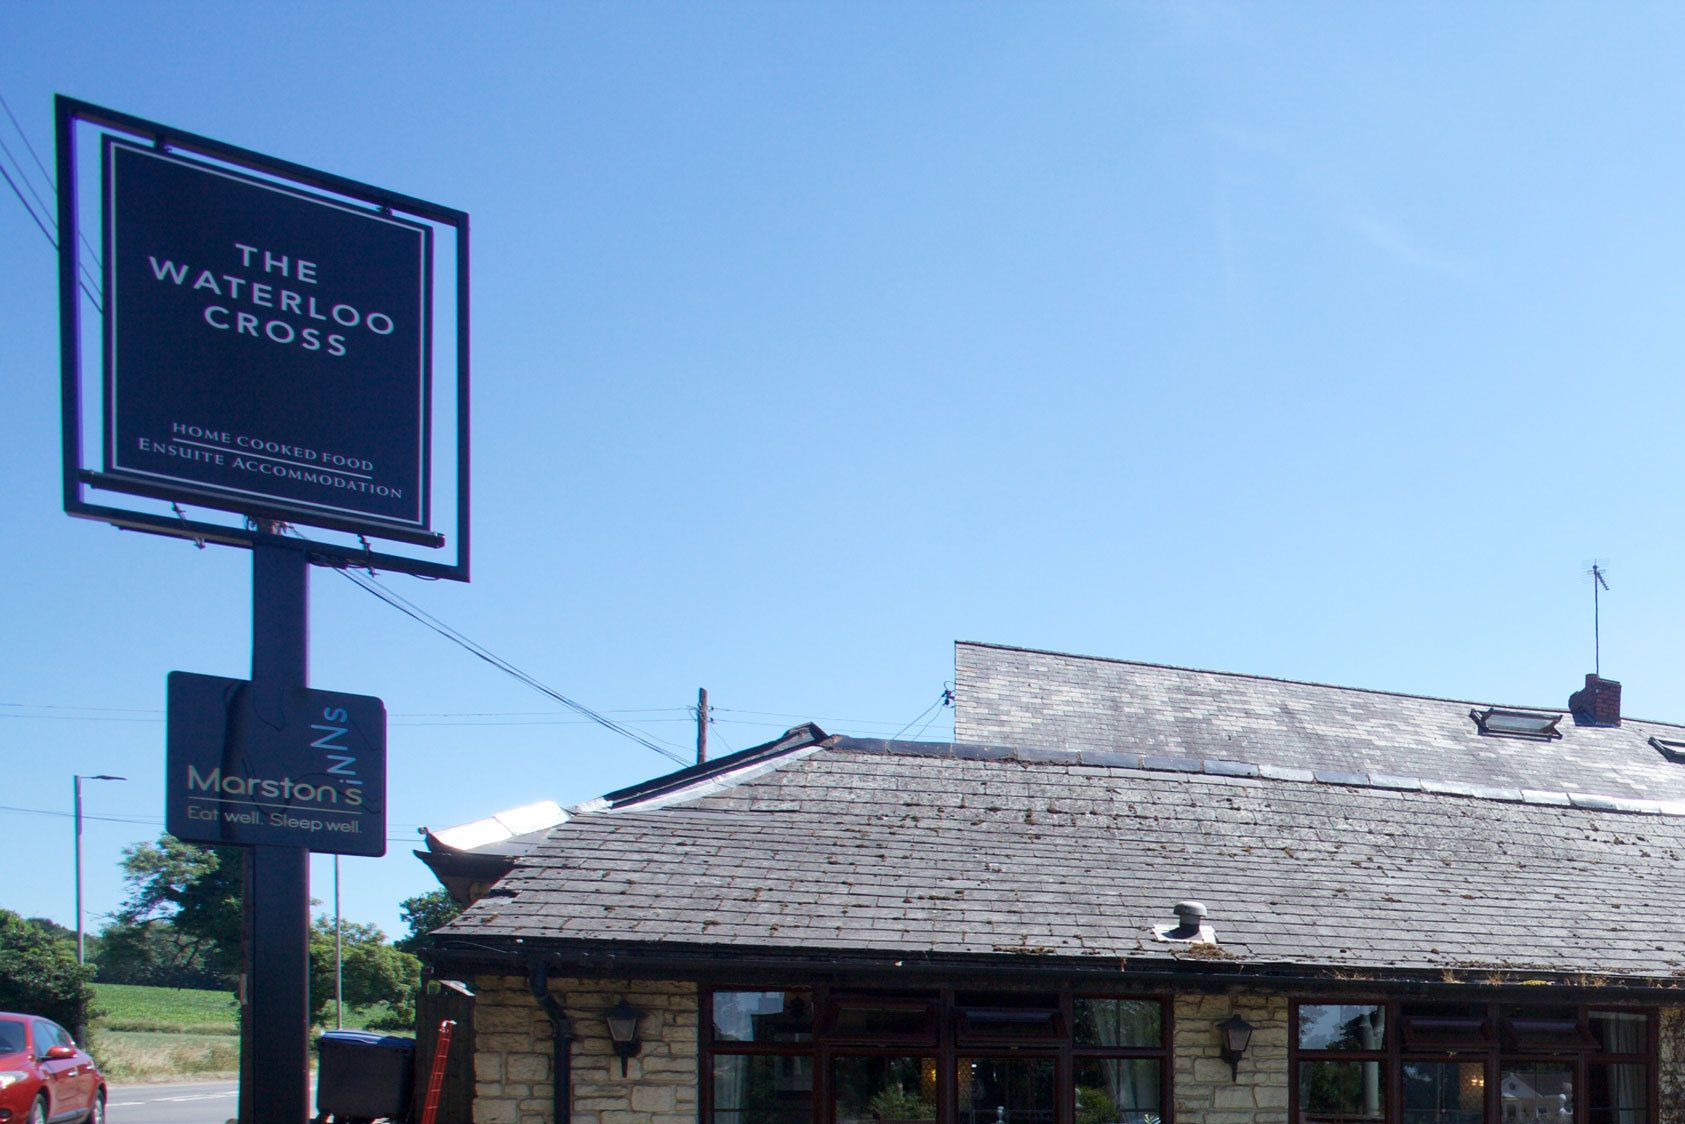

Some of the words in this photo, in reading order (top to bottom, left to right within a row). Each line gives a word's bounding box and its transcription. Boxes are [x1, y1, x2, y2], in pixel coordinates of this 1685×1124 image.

[235, 243, 318, 284] THE
[149, 256, 395, 335] WATERLOO
[204, 305, 347, 357] CROSS
[172, 422, 232, 444] HOME
[236, 436, 318, 461] COOKED
[322, 452, 374, 472] FOOD
[187, 805, 219, 821] Eat
[224, 810, 264, 825] well.
[270, 812, 323, 832] Sleep
[326, 821, 363, 833] well.
